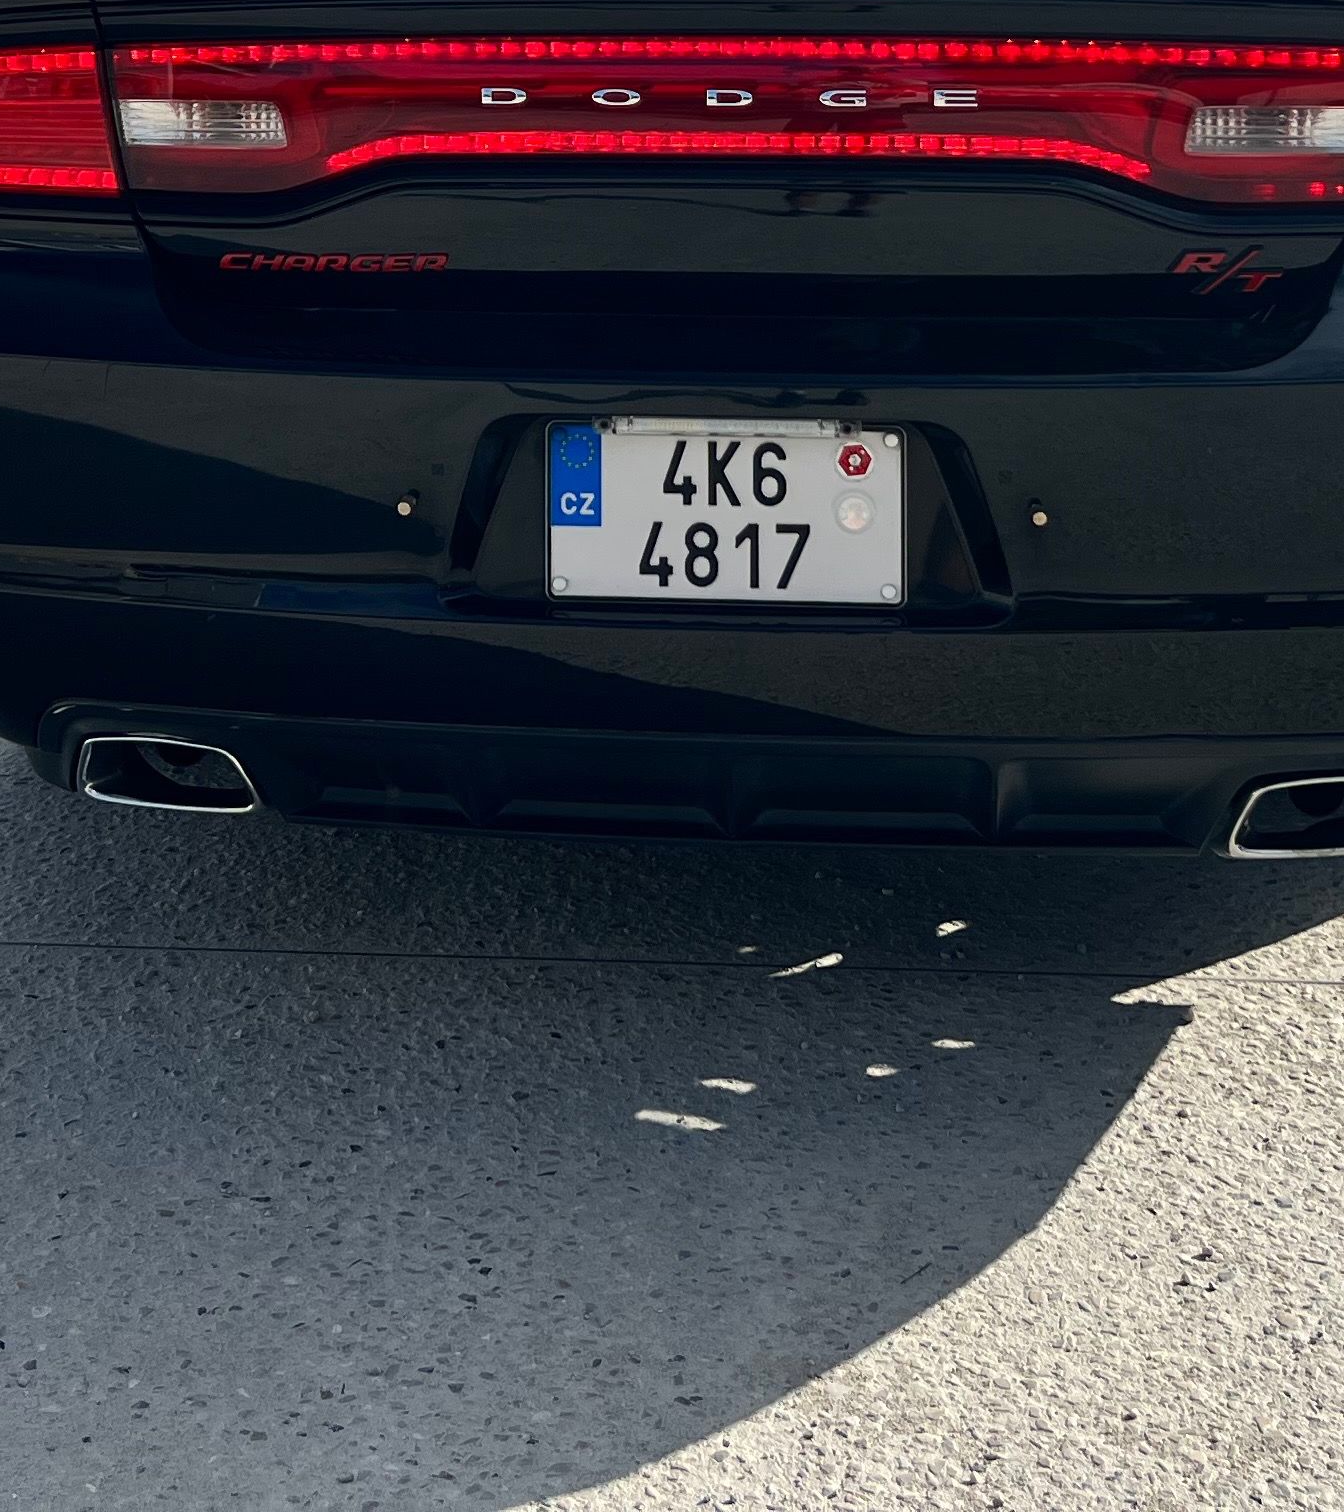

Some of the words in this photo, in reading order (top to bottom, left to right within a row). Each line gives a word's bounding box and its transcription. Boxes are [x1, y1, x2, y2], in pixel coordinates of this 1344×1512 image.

[481, 87, 979, 107] DODGE
[219, 252, 449, 272] CHARGER
[1169, 245, 1285, 295] R/T
[662, 440, 788, 506] 4K6
[560, 492, 595, 515] CZ
[639, 521, 811, 589] 4817
